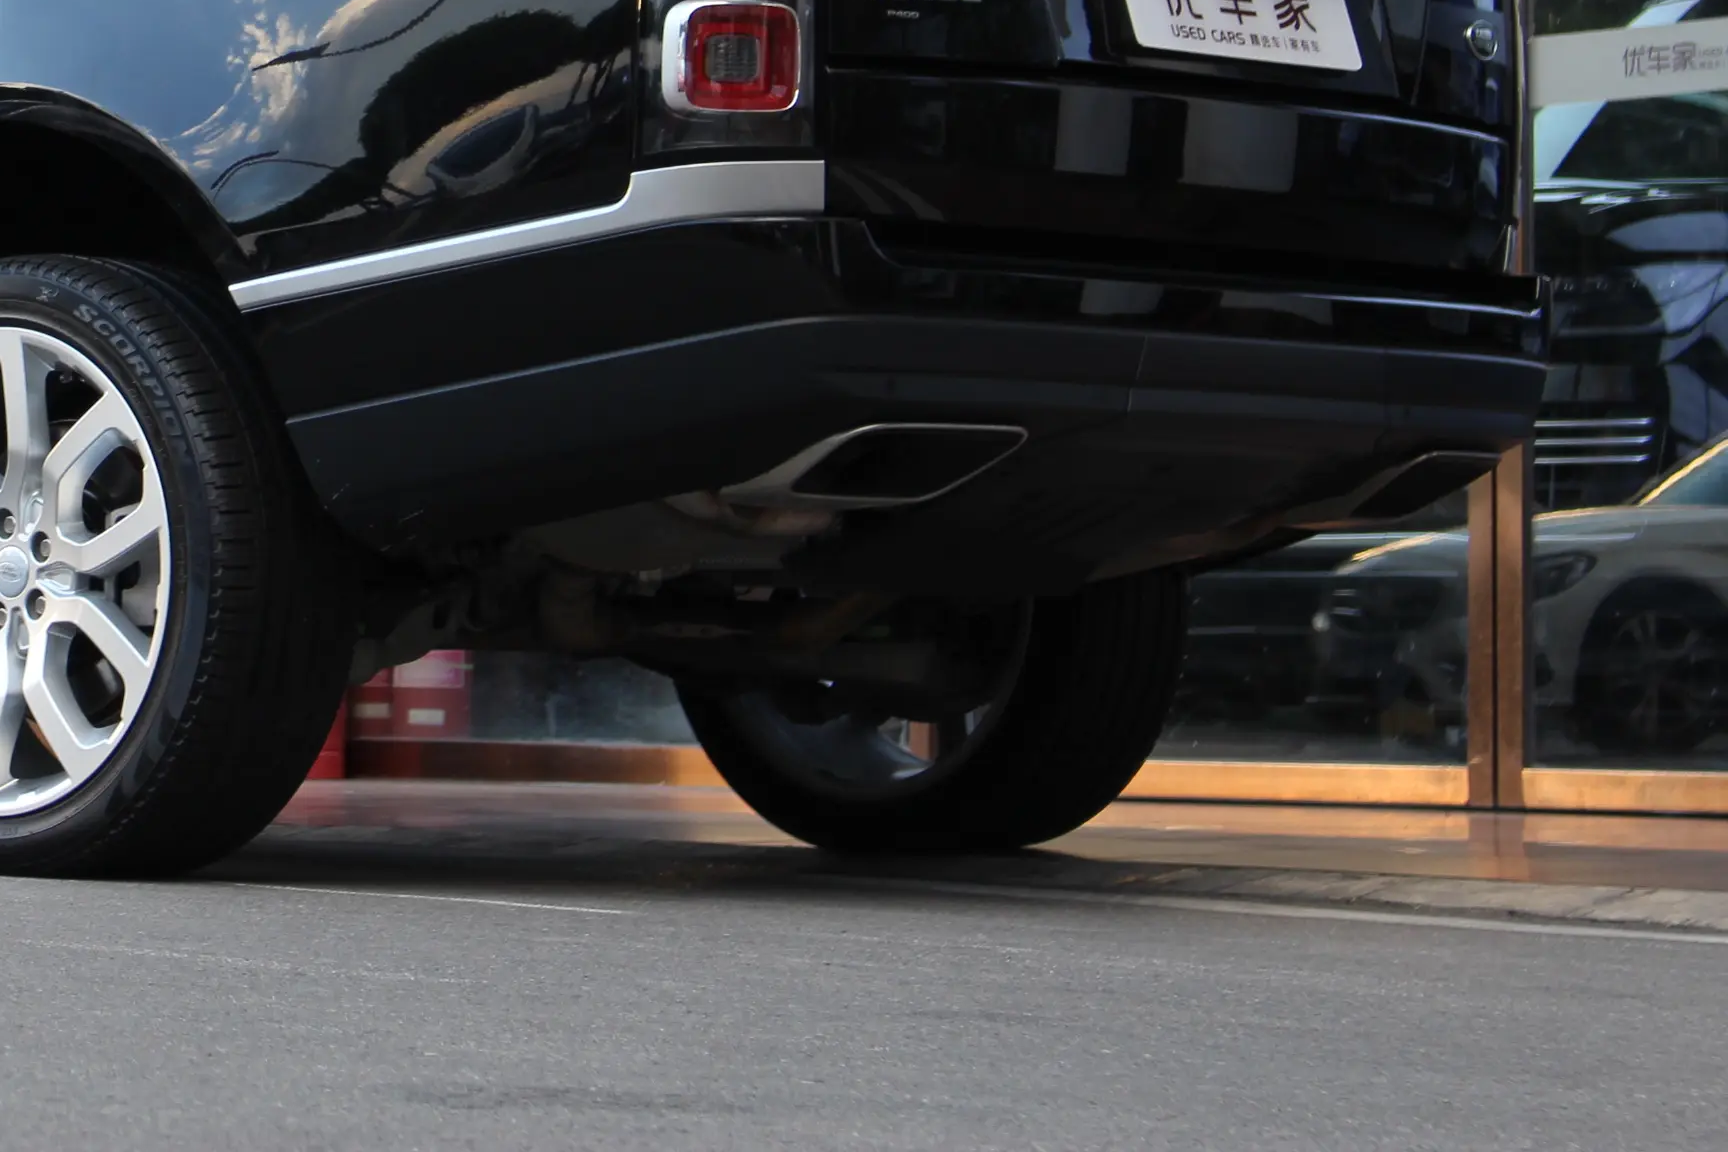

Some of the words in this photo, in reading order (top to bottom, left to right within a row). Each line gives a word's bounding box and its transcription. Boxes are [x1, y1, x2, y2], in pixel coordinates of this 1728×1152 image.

[1170, 23, 1206, 42] USED
[1210, 29, 1246, 46] CARS
[1623, 40, 1699, 78] 优车家
[74, 303, 187, 456] SCORPIO
